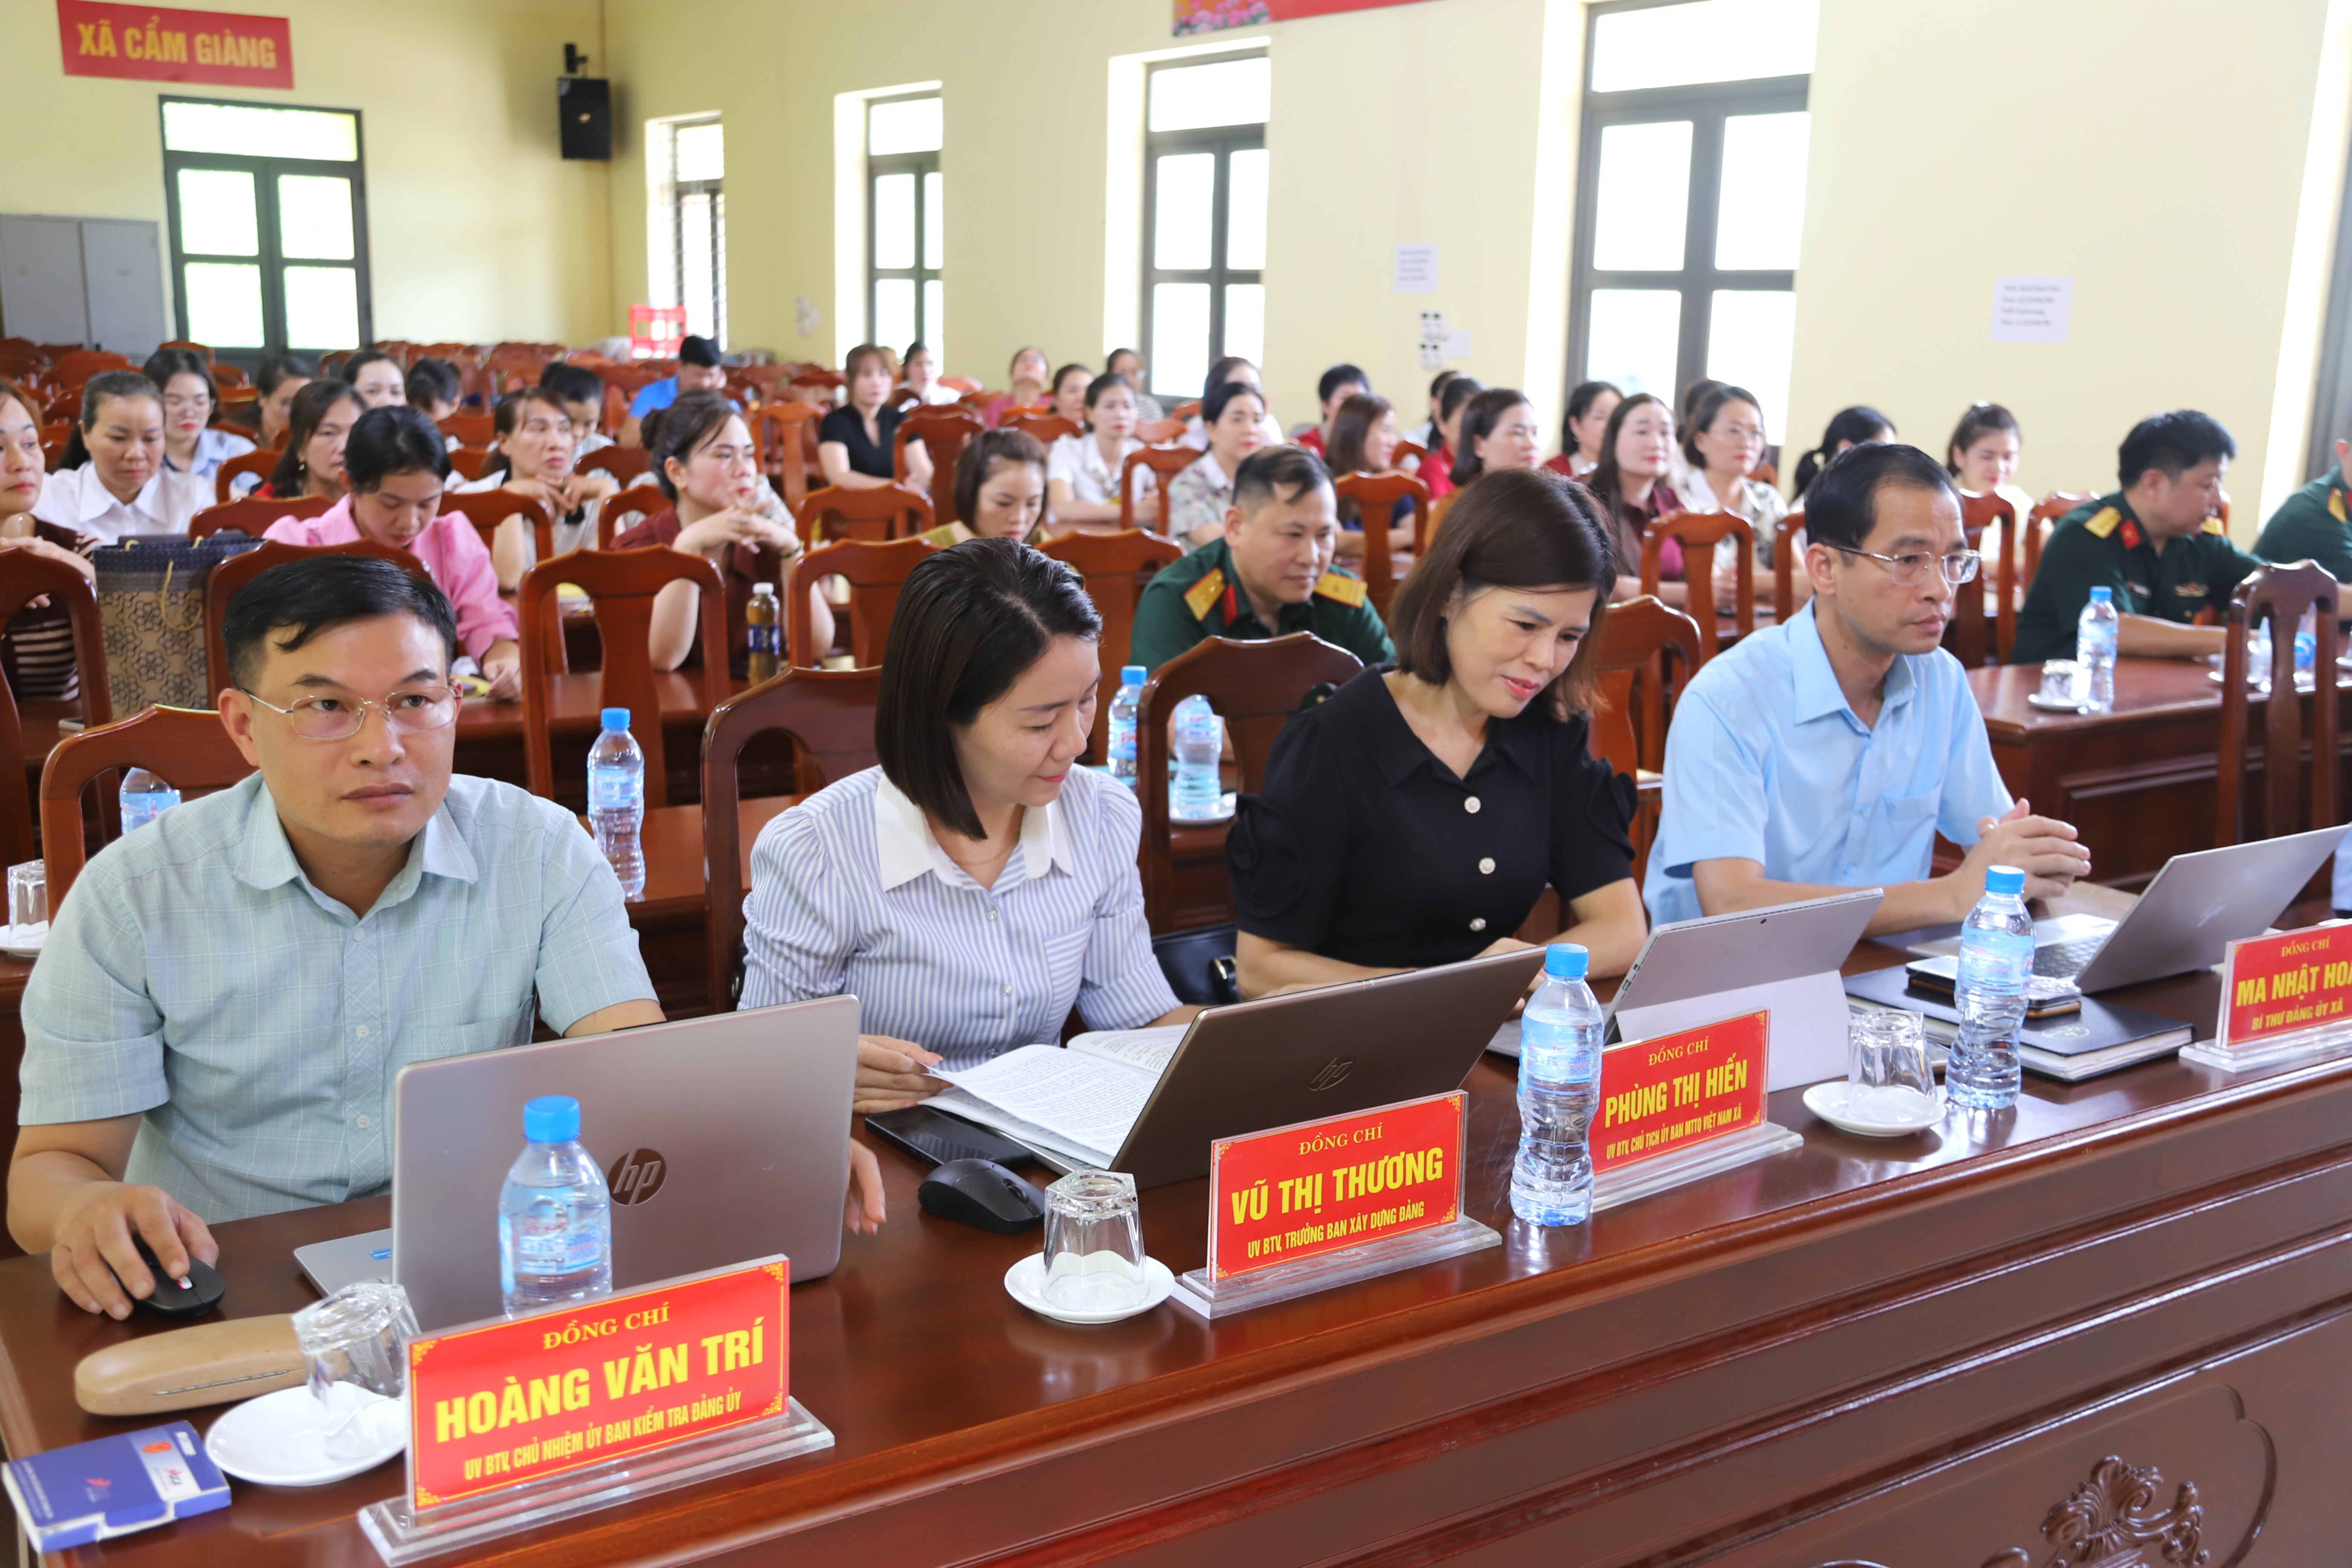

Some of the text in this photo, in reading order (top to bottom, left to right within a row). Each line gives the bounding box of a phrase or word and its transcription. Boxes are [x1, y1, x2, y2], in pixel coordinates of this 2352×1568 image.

[77, 15, 277, 69] XÃ CẨM GIÀNG
[2282, 936, 2329, 957] ĐỒNG CHÍ
[2236, 977, 2266, 1007] MA
[2271, 963, 2320, 1000] NHẬT
[1649, 1036, 1708, 1066] ĐỒNG CHÍ
[1605, 1052, 1747, 1128] PHÙNG THỊ HIẾN
[1299, 1122, 1382, 1155] ĐỒNG CHÍ
[1606, 1144, 1616, 1159] UV
[1631, 1130, 1645, 1152] CHỦ
[1645, 1130, 1660, 1150] TỊCH
[1661, 1123, 1669, 1143] ỦY
[1670, 1122, 1684, 1140] BAN
[1684, 1117, 1702, 1136] MTTQ
[1703, 1111, 1717, 1132] VIỆT
[1717, 1108, 1732, 1125] NAM
[1733, 1103, 1741, 1121] XÃ
[613, 1150, 662, 1207] hp
[1231, 1147, 1443, 1225] VŨ THỊ THƯƠNG
[1248, 1199, 1424, 1258] UV BTV, TRƯỞNG BAN XÂY DỤNG ĐẢNG
[543, 1302, 669, 1349] ĐỒNG CHÍ
[435, 1316, 765, 1444] HOÀNG VĂN TRÍ
[464, 1457, 483, 1481] UV
[512, 1437, 540, 1468] CHỦ
[542, 1430, 584, 1461] NHIỆM
[585, 1423, 603, 1449] ỦY
[605, 1419, 632, 1444] BAN
[633, 1406, 665, 1437] KIỂM
[666, 1405, 690, 1428] TRA
[691, 1394, 724, 1422] ĐẢNG
[726, 1387, 742, 1412] ỦY
